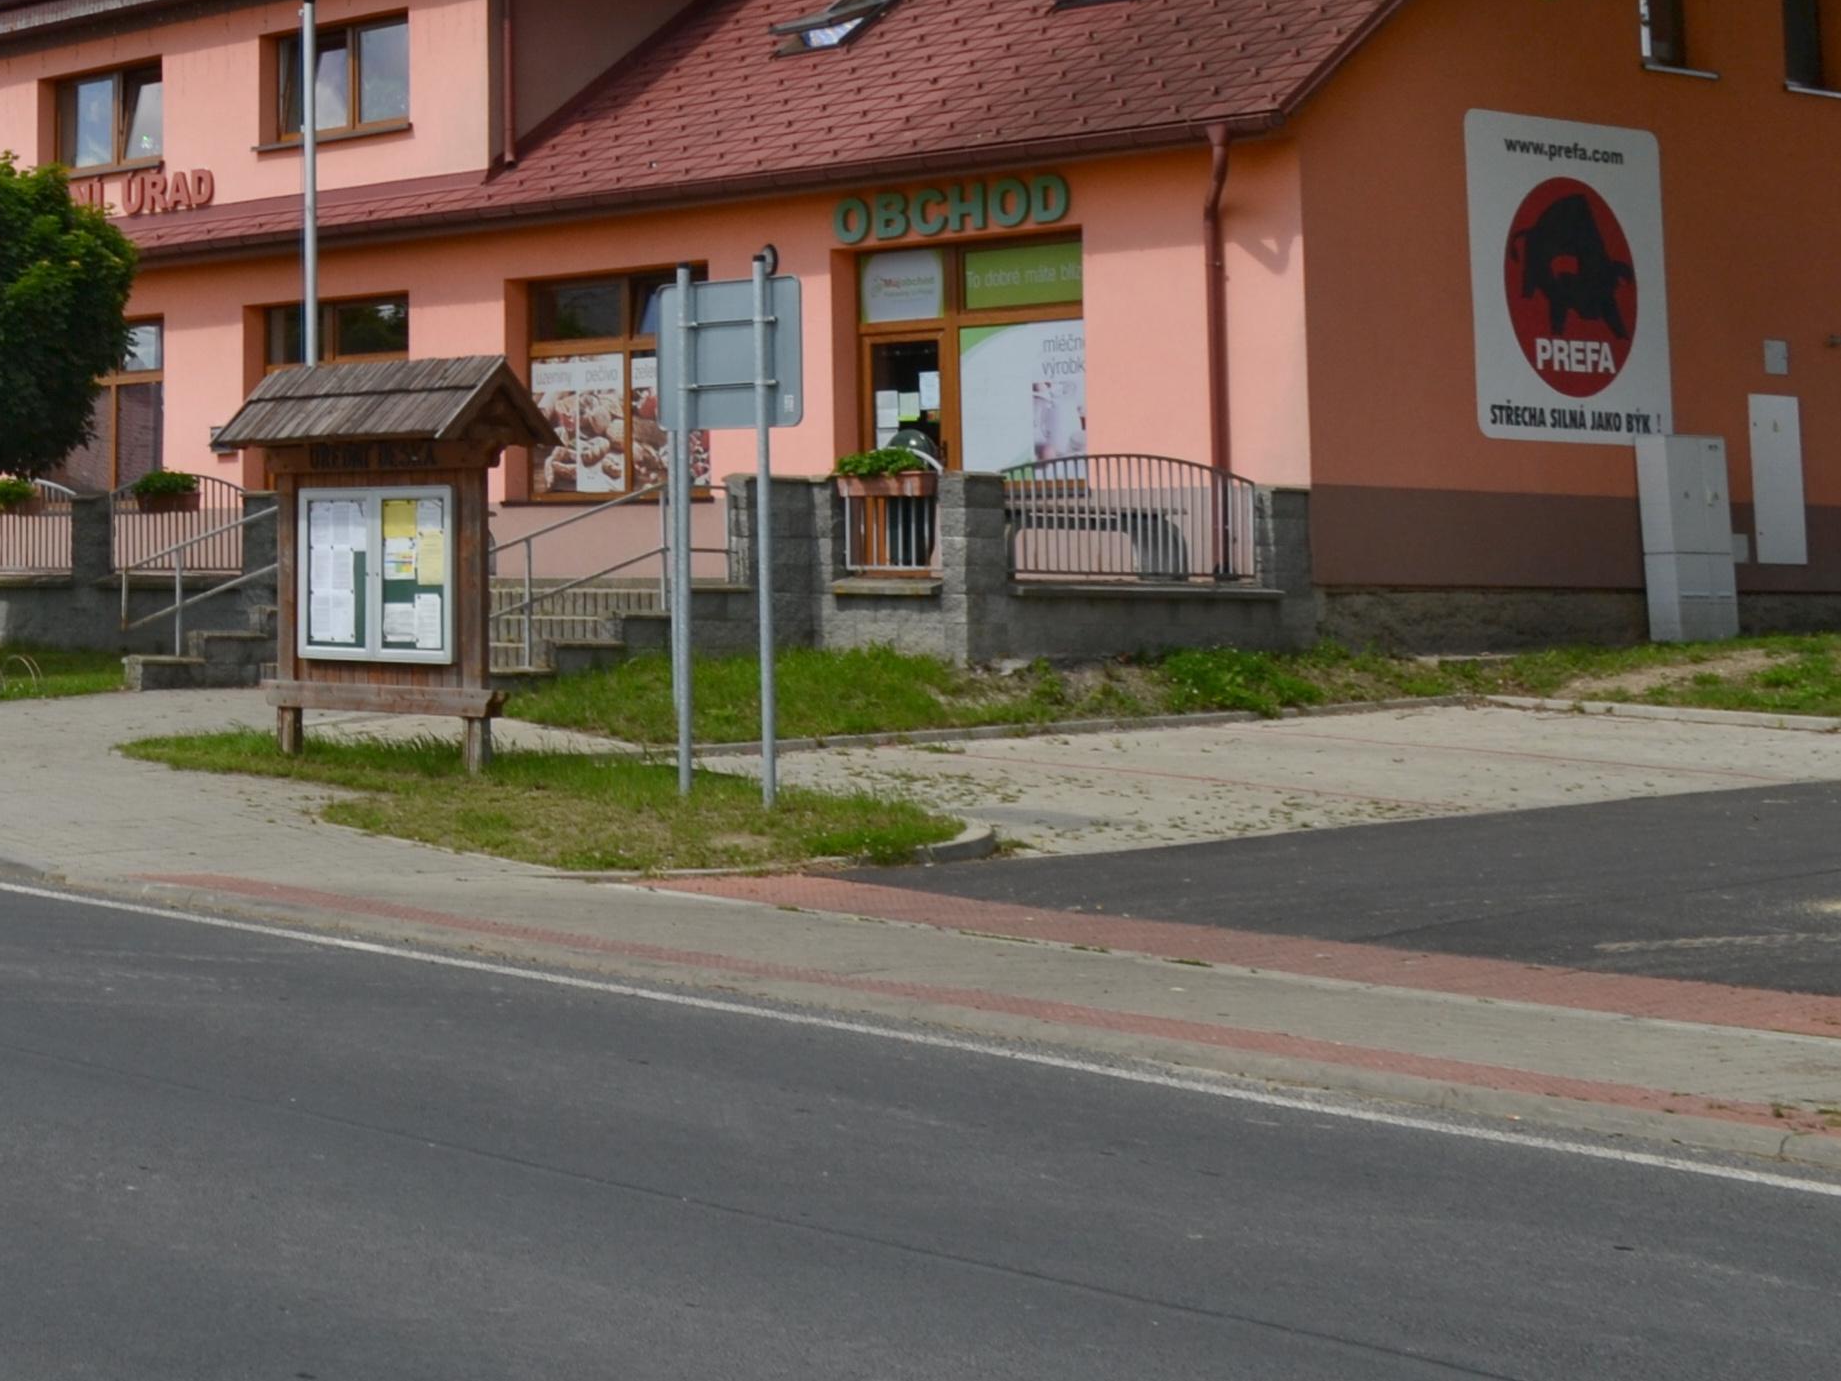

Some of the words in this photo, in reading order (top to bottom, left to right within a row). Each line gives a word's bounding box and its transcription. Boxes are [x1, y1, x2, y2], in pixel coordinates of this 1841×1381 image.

[1504, 138, 1624, 165] www.prefa.com
[121, 165, 215, 216] ÚŘAD
[833, 174, 1070, 245] OBCHOD
[984, 268, 1021, 288] dobré
[1024, 264, 1057, 284] máte
[1042, 333, 1085, 352] mléčn
[1535, 338, 1617, 374] PREFA
[585, 365, 619, 383] pečivo
[1490, 399, 1547, 428] STŘECHA
[1550, 404, 1588, 430] SILNÁ
[1591, 412, 1622, 432] JAKO
[1626, 408, 1652, 434] BÝK
